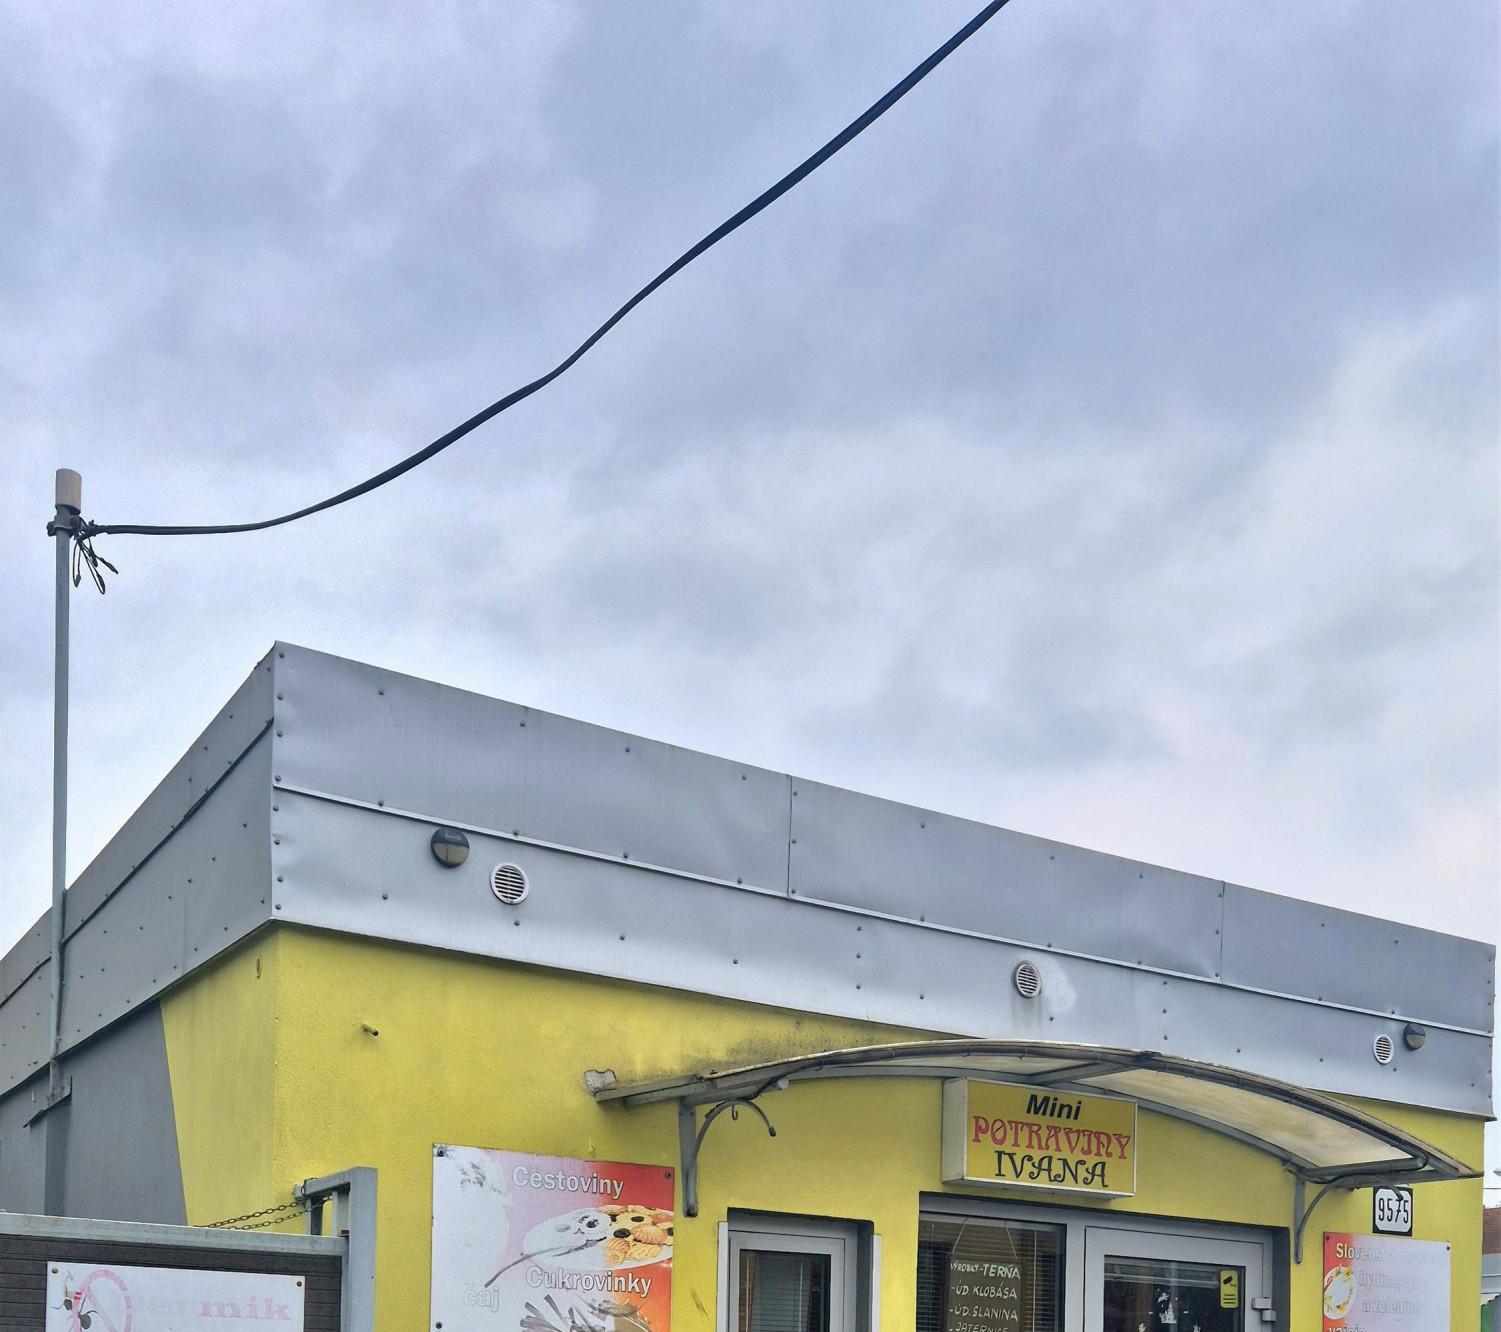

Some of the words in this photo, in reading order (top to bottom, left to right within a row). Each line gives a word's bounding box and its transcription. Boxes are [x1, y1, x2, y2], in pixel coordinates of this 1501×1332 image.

[1026, 1094, 1082, 1120] Mini
[972, 1115, 1131, 1160] POTRAVINY
[511, 1165, 624, 1199] Cestoviny
[995, 1151, 1109, 1188] IVANA
[1378, 1197, 1409, 1224] 9575
[525, 1265, 652, 1297] Cukrovinky
[973, 1281, 1018, 1300] KLOBÁSA
[972, 1305, 1019, 1322] SLANINA
